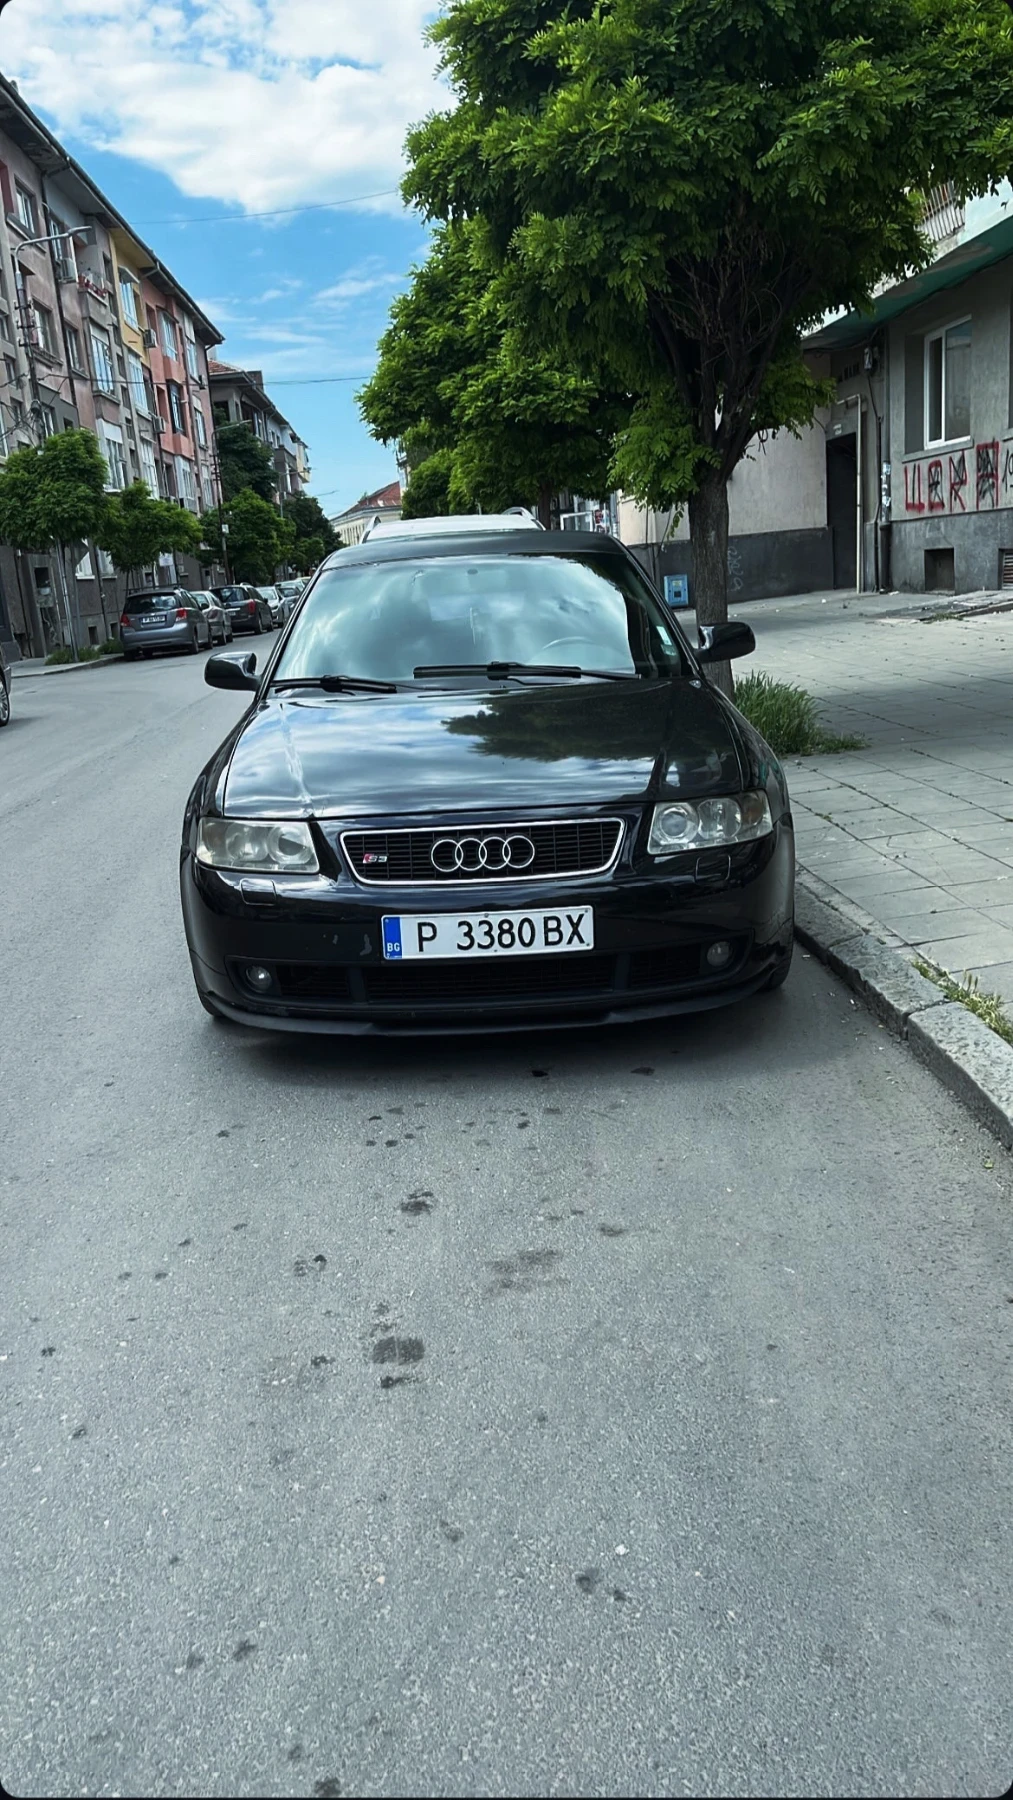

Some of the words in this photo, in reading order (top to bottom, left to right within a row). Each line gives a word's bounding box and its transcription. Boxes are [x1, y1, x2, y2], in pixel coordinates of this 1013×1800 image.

[365, 854, 388, 863] S3
[417, 922, 437, 952] P
[387, 942, 400, 952] BG
